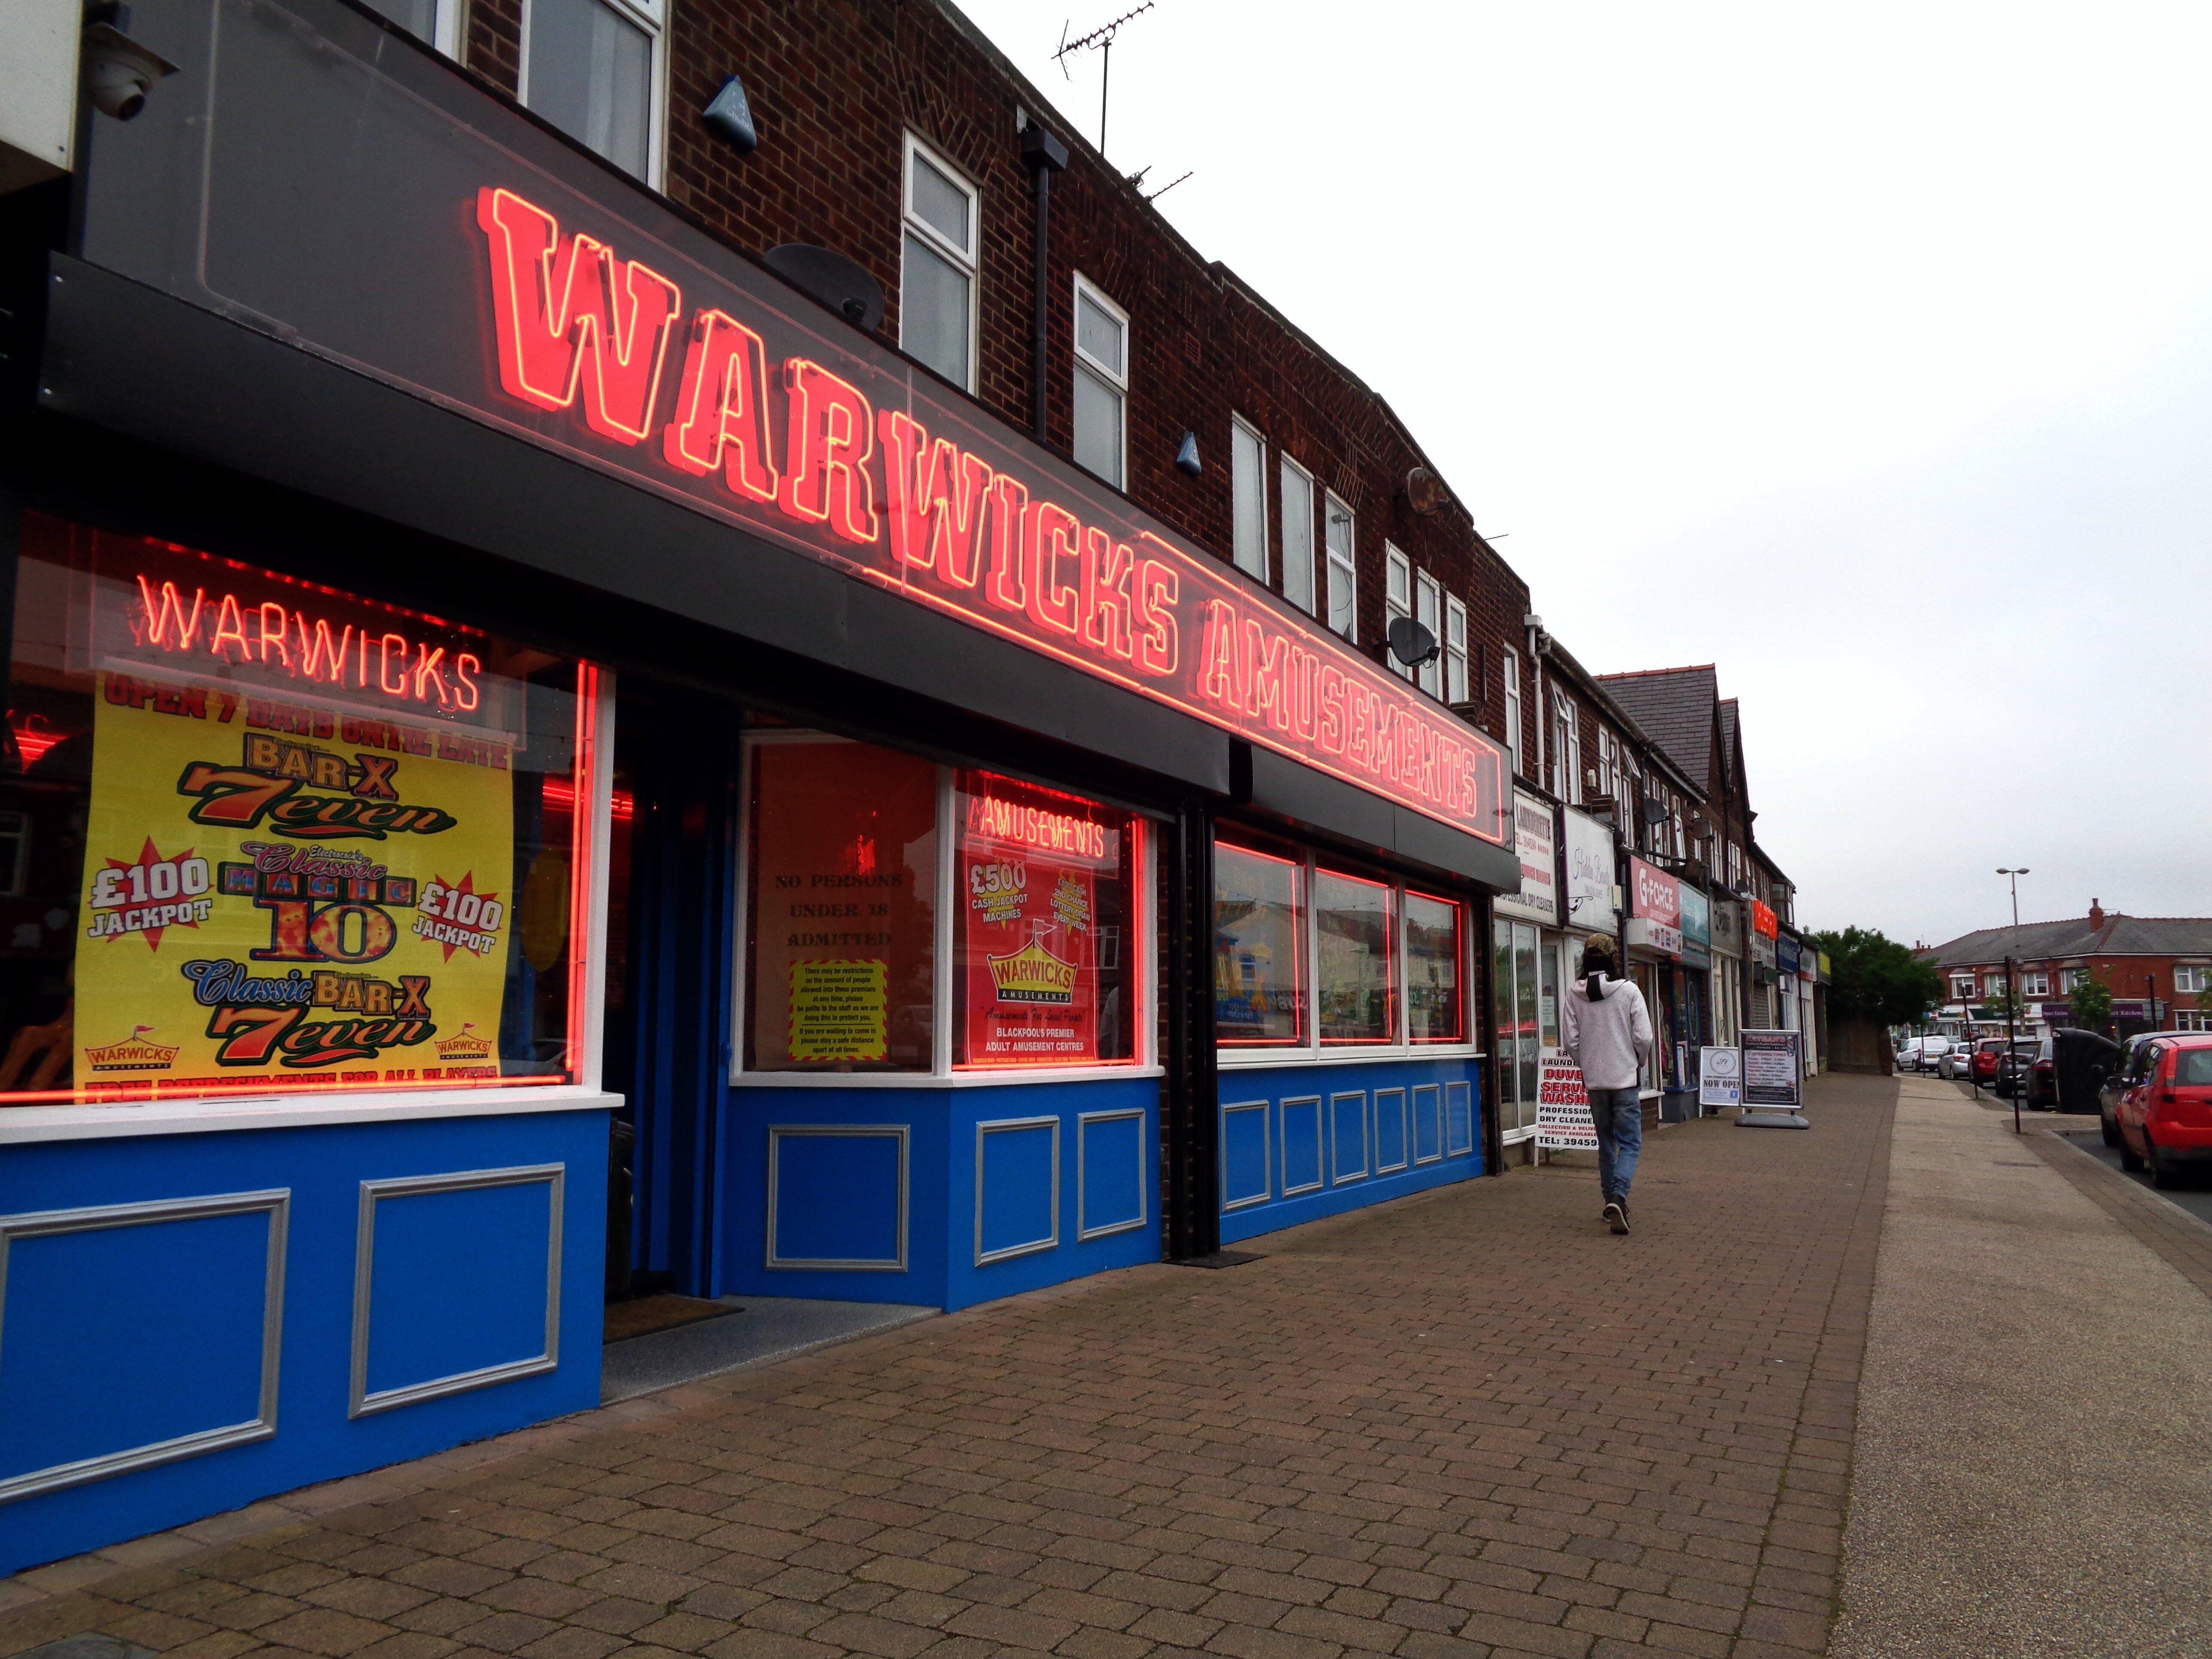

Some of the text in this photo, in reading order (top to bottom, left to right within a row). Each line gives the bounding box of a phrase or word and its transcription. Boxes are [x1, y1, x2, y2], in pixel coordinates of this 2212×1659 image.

[477, 186, 1477, 818] WARWICKS AMUSEMENTS
[137, 574, 481, 711] WARWICKS
[105, 672, 207, 720] OPEN
[218, 691, 240, 724] 7
[246, 699, 334, 739] DAYS
[243, 732, 399, 802] BAR-X
[176, 761, 457, 835] 7even
[980, 796, 1104, 857] AMUSEMENTS
[240, 842, 387, 880] Classic
[90, 857, 210, 910] £100
[224, 864, 414, 905] MAGIC
[775, 874, 902, 888] NO PERSONS
[971, 863, 1026, 894] £500
[1073, 884, 1086, 896] CASH
[1639, 868, 1674, 911] G-FORCE
[417, 881, 503, 932] £100
[790, 903, 889, 917] UNDER 18
[972, 893, 1028, 909] CASH JACKPOT
[1050, 898, 1091, 921] LOTTERY DRAW
[1054, 888, 1088, 908] 2ND CHANCE
[87, 899, 213, 937] JACKPOT
[249, 898, 397, 963] 10
[983, 908, 1021, 923] MACHINES
[1054, 911, 1087, 932] EVERY WEEK
[412, 915, 496, 954] JACKPOT
[787, 932, 891, 945] ADMITTED
[181, 959, 431, 1020] Classic BAR-X
[996, 960, 1071, 989] WARWICKS
[1002, 991, 1068, 1000] AMUSEMENTS
[205, 1004, 437, 1066] 7even
[438, 1041, 488, 1053] WARWICKS
[985, 1042, 1084, 1051] ADULT AMUSEMENT CENTRES
[997, 1027, 1074, 1038] BLACKPOOL'S PREMIER
[91, 1047, 172, 1063] WARWICKS
[1544, 1069, 1582, 1081] DUVE
[1704, 1079, 1720, 1088] NOW
